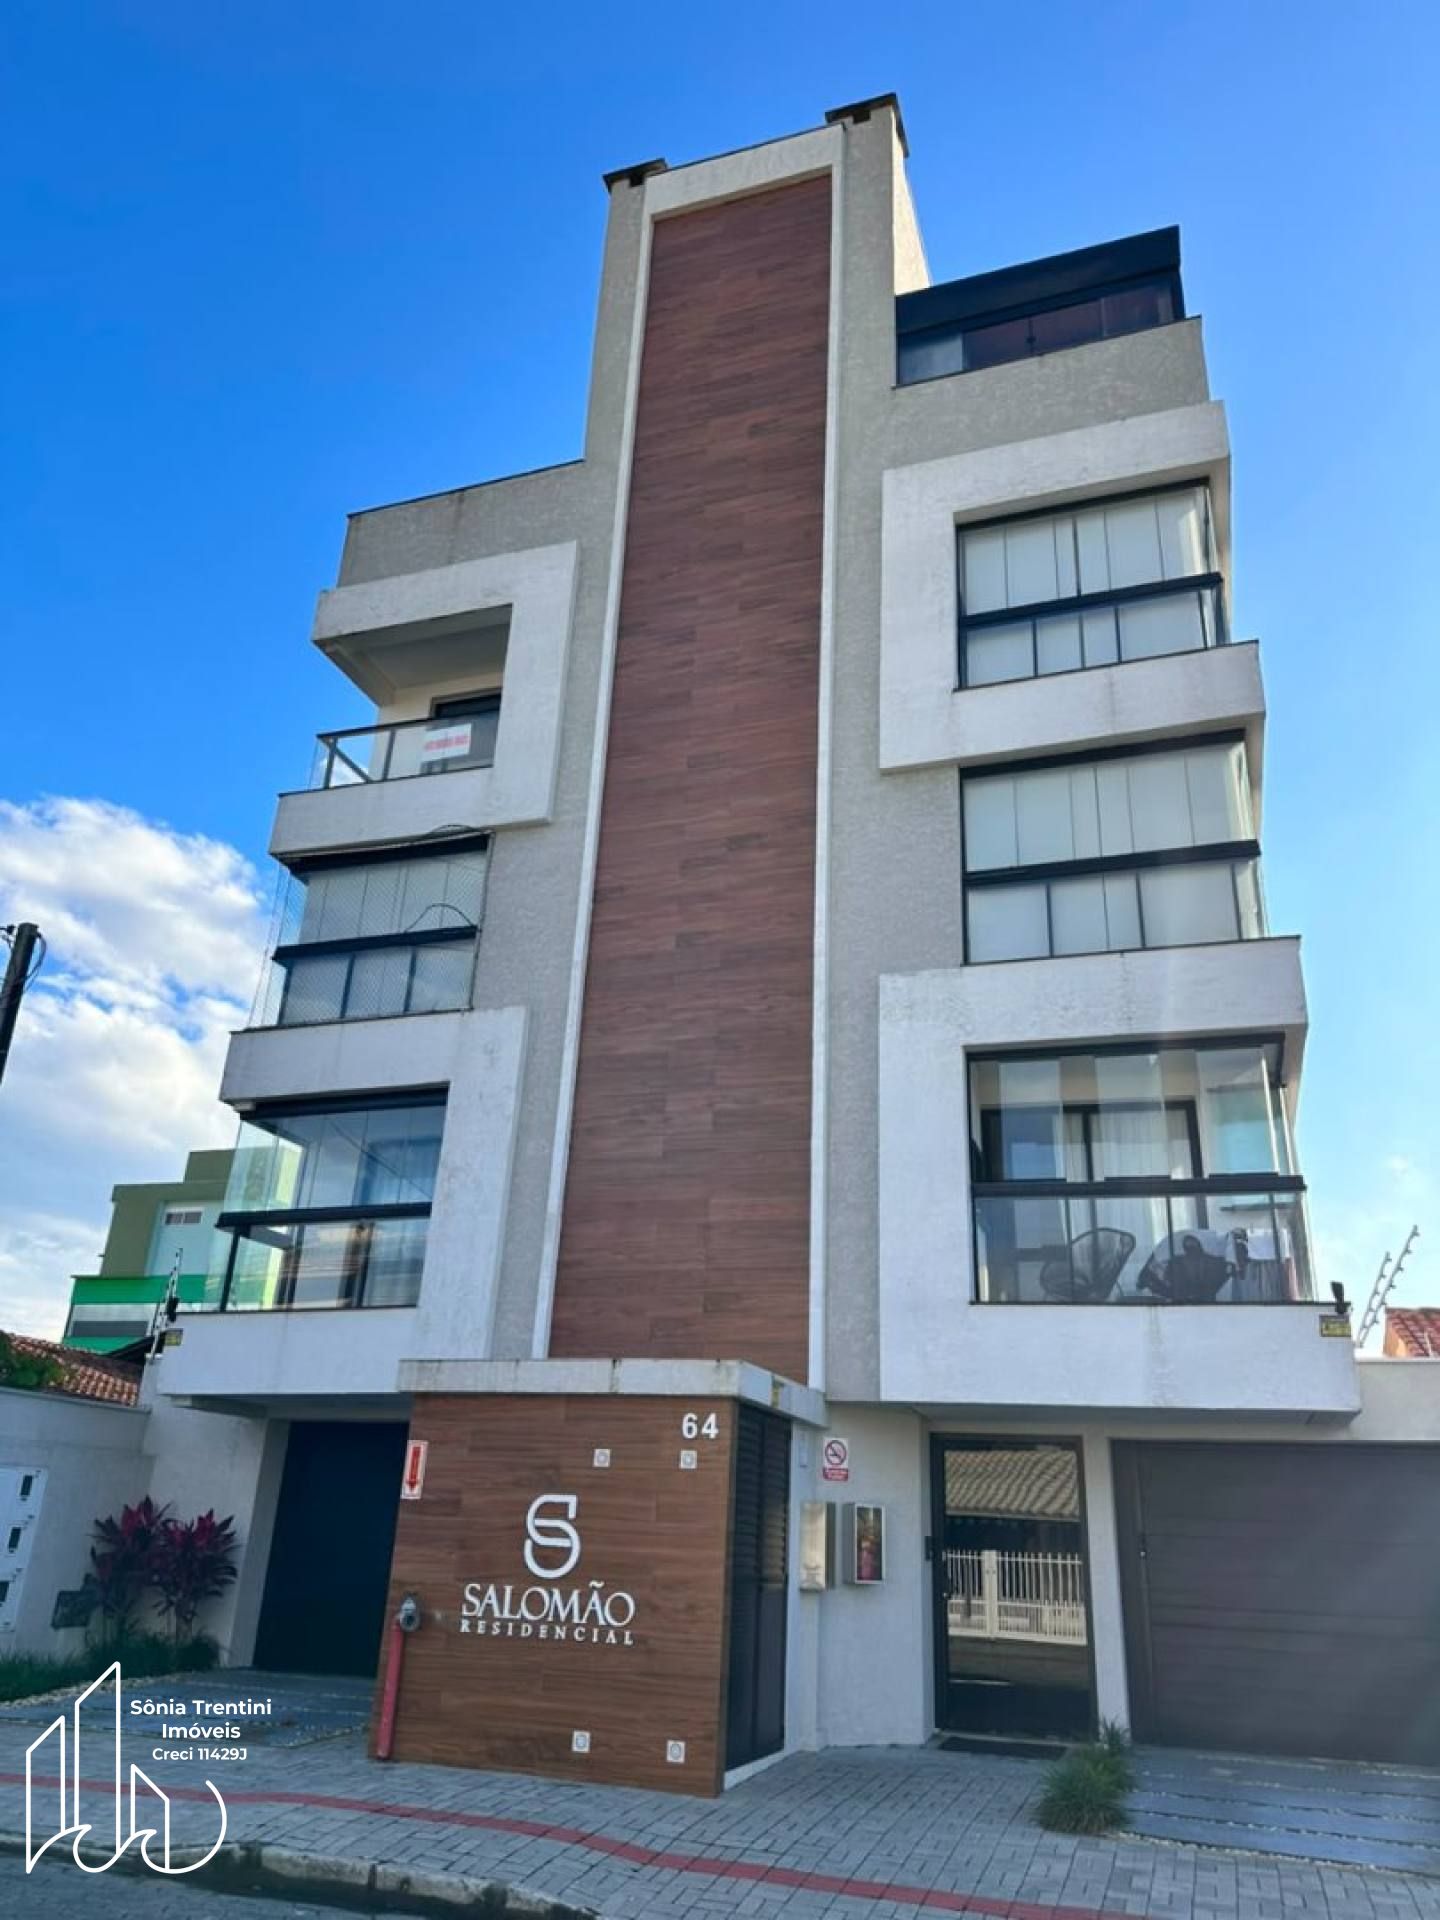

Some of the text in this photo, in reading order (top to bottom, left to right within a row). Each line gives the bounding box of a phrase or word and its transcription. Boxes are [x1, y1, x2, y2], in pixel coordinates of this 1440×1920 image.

[682, 1413, 719, 1439] 64
[461, 1581, 636, 1627] SALOMÃO
[459, 1619, 634, 1645] RESIDENCIAL
